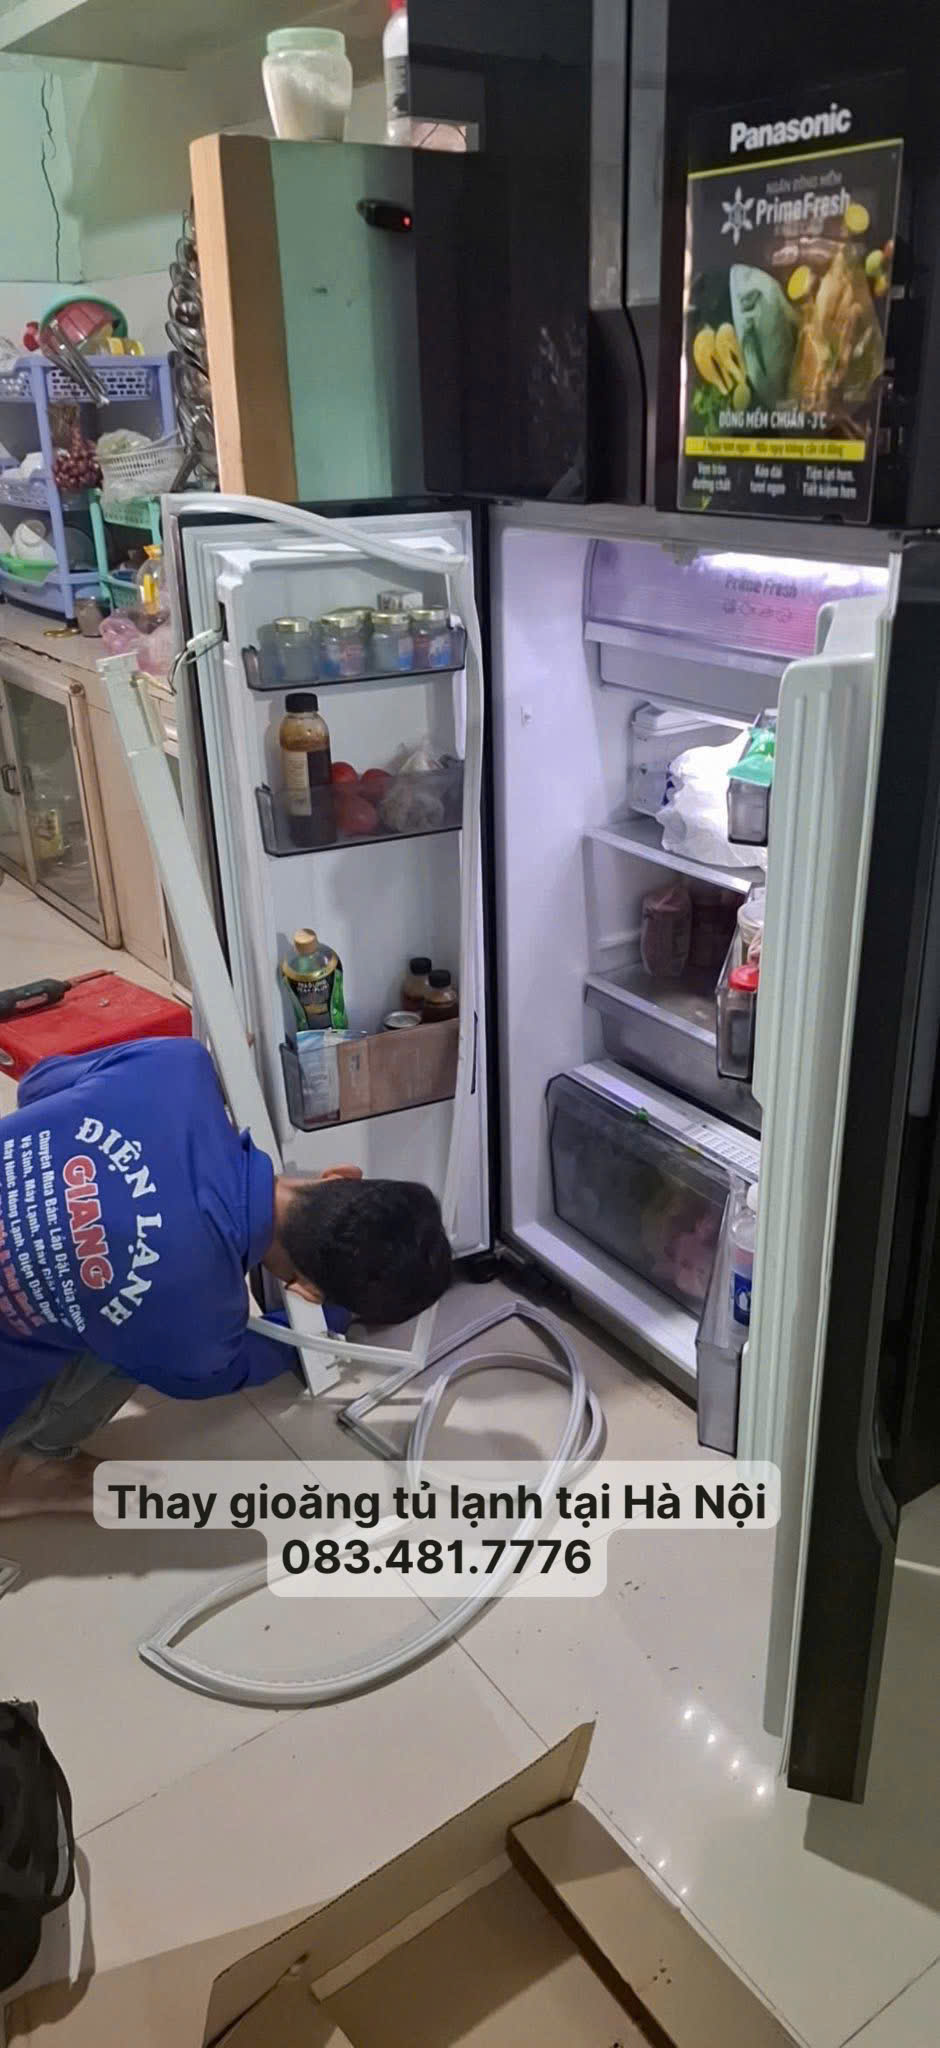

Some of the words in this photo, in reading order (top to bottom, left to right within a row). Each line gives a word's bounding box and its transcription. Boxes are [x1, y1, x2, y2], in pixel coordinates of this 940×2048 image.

[730, 102, 852, 153] Panasonic
[38, 1129, 52, 1169] Chuyên
[75, 1117, 157, 1198] ĐIỆN
[42, 1170, 55, 1196] Mua
[63, 1155, 114, 1289] GIANG
[100, 1213, 162, 1326] LẠNH
